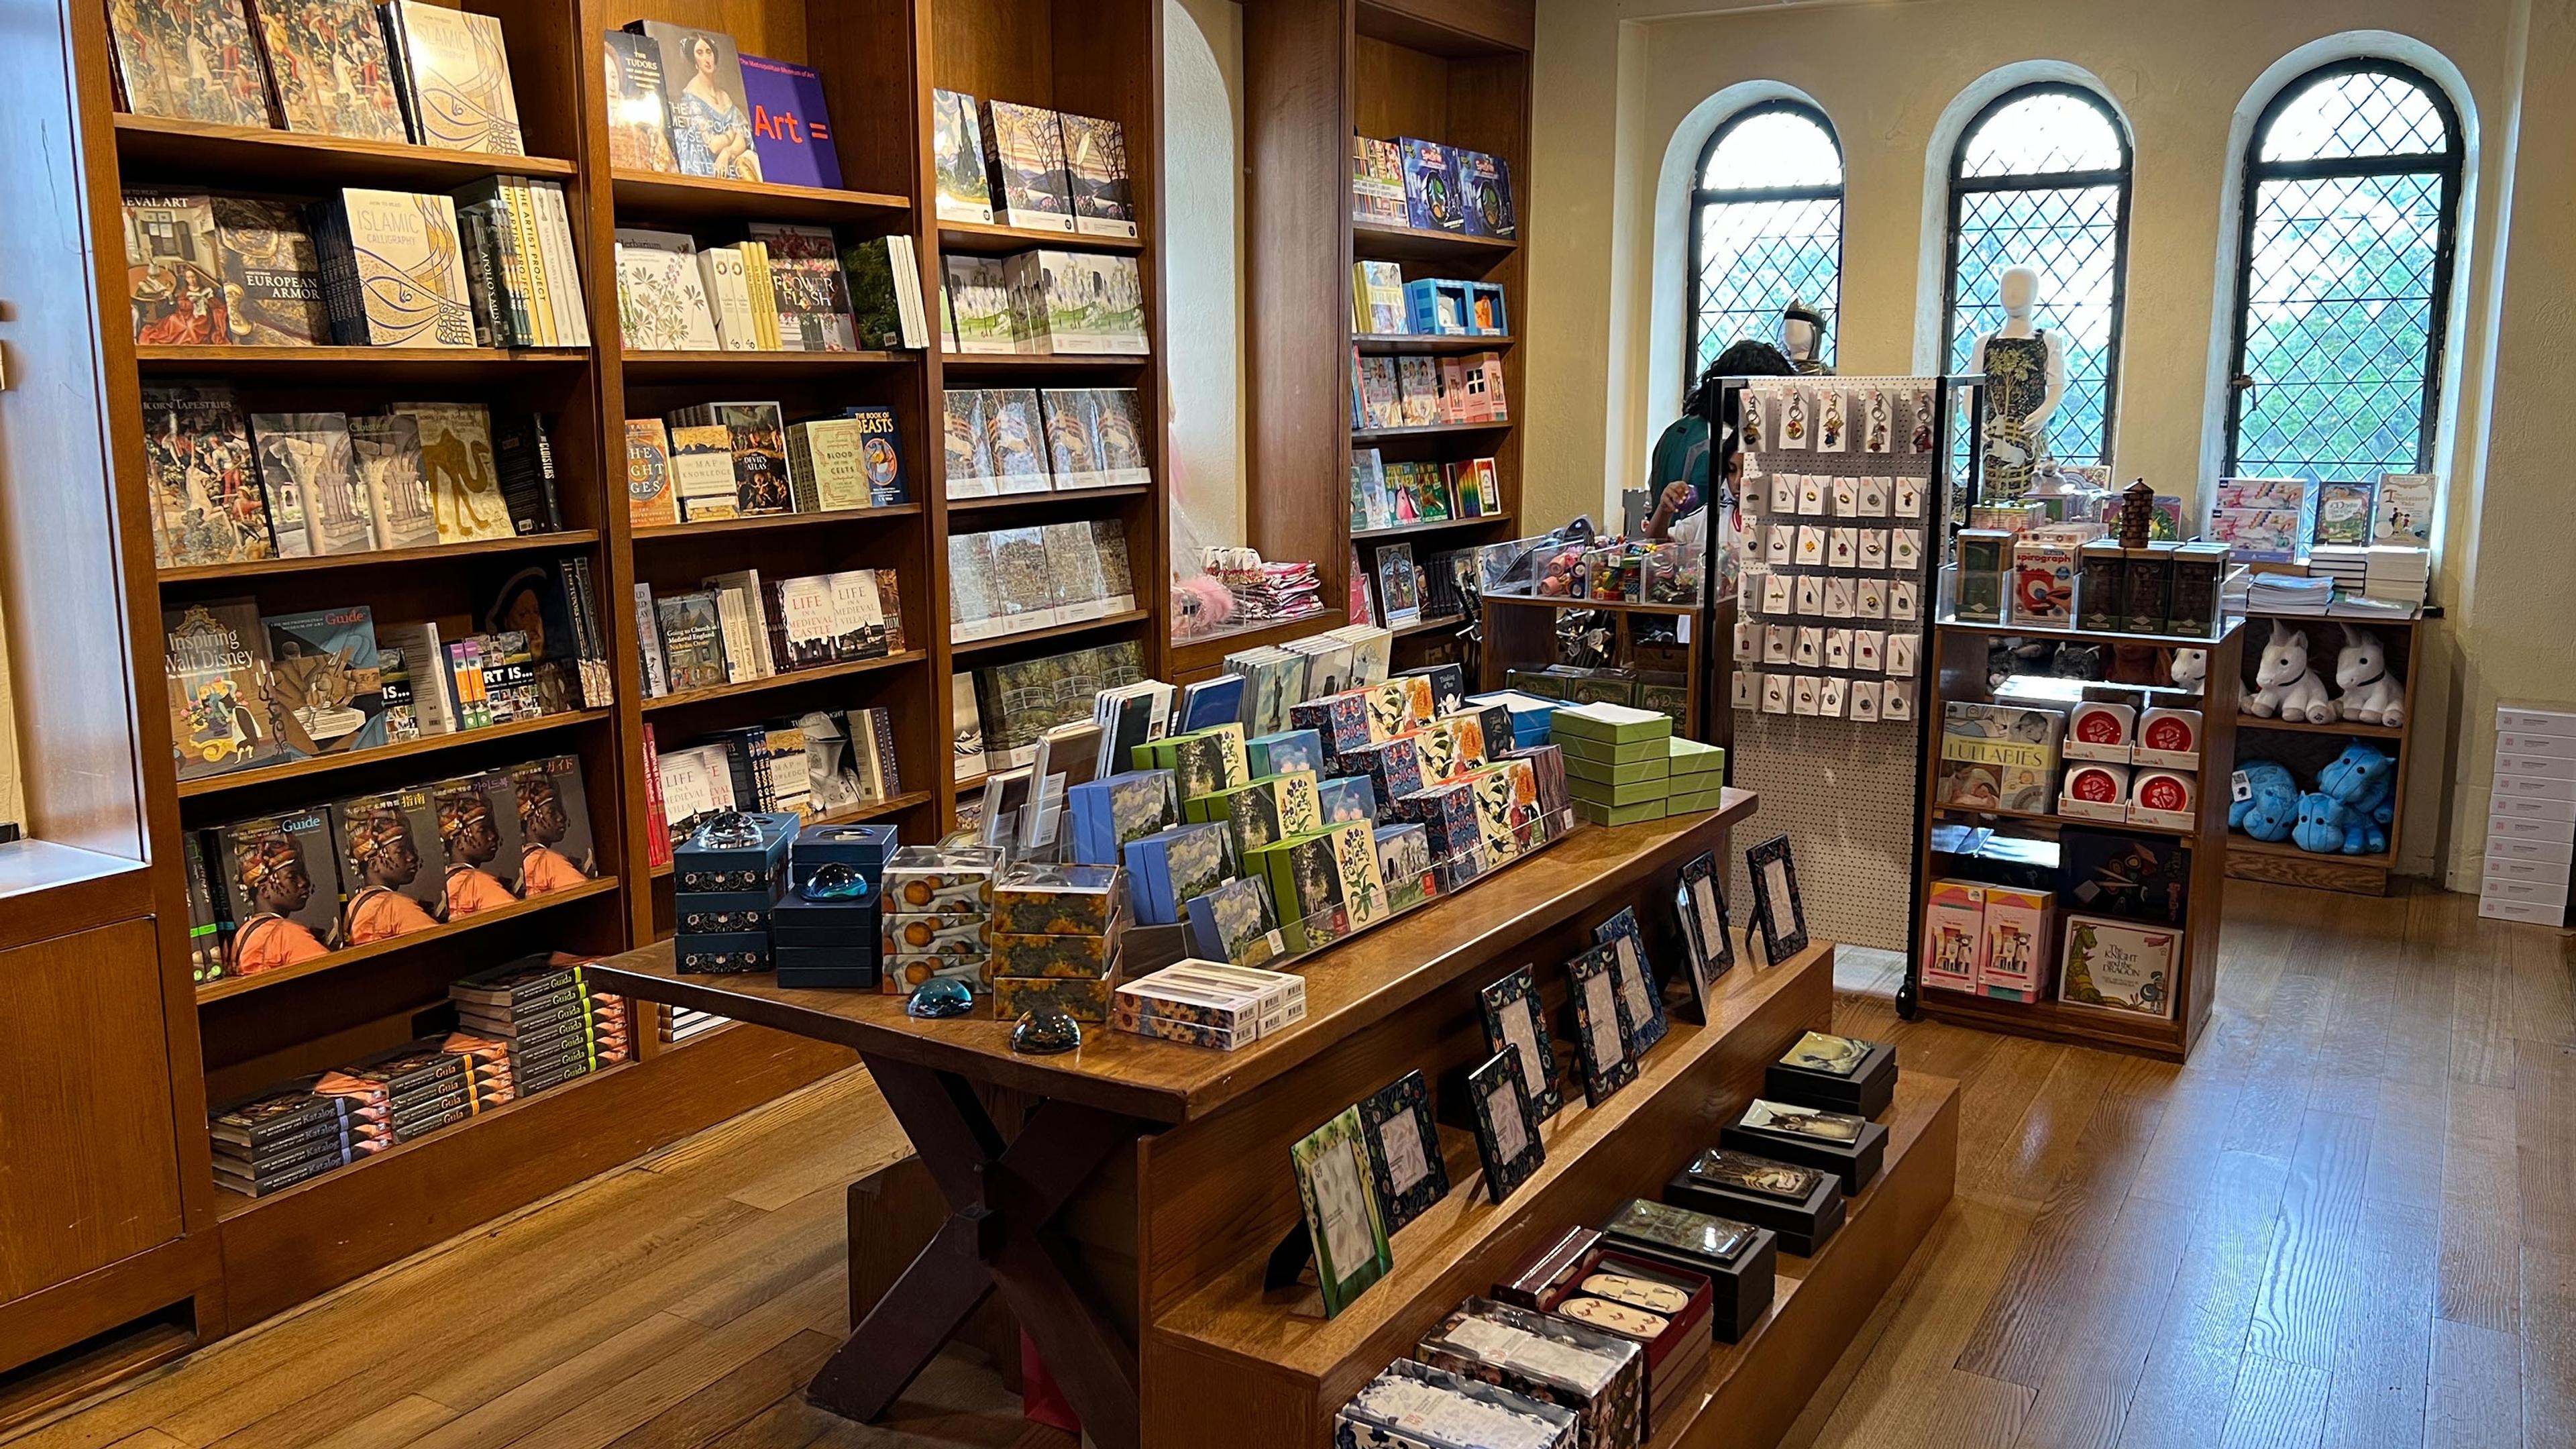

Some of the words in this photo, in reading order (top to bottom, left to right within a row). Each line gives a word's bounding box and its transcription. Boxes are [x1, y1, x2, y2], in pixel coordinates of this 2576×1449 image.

[625, 58, 657, 70] TUDORS
[755, 105, 803, 144] Art
[162, 197, 189, 208] ART
[519, 187, 529, 207] THE
[357, 210, 419, 233] ISLAMIC
[523, 212, 536, 249] ARTIST
[366, 233, 417, 246] CALLIGRAPHY
[508, 211, 521, 249] ARTIST
[517, 253, 532, 302] PROJECT
[247, 276, 317, 288] EUROPEAN
[531, 254, 547, 301] PROJECT
[772, 274, 835, 292] FLOWER
[272, 288, 321, 299] ARMOR
[783, 290, 832, 307] FLASH
[858, 418, 894, 434] BEASTS
[744, 455, 767, 464] DEVIL'S
[827, 451, 853, 460] BLOOD
[630, 464, 664, 477] GHT
[696, 460, 718, 468] MAP
[747, 463, 767, 471] ATLAS
[830, 466, 855, 475] CELTS
[682, 469, 732, 478] KNOWLEDGE
[630, 480, 661, 494] GES
[2017, 554, 2071, 564] spirograph
[839, 586, 867, 600] LIFE
[792, 594, 822, 610] LIFE
[836, 604, 876, 616] MEDIEVAL
[325, 609, 365, 626] Guide
[788, 616, 833, 629] MEDIEVAL
[840, 614, 873, 626] VILLAGE
[667, 629, 684, 637] Going
[691, 625, 711, 633] Church
[668, 635, 692, 643] Medieval
[693, 631, 715, 641] England
[792, 625, 831, 638] CASTLE
[168, 630, 239, 653] Inspiring
[165, 654, 198, 674] Walt
[202, 650, 254, 669] Disney
[508, 667, 534, 680] IS...
[1949, 743, 2043, 767] LULLABIES
[547, 758, 573, 772] ガイド
[775, 762, 794, 771] MAP
[473, 777, 509, 791] 가이드북
[666, 771, 695, 788] LIFE
[402, 793, 426, 808] 指南
[667, 800, 702, 814] VILLAGE
[282, 816, 321, 833] Guide
[2109, 944, 2123, 953] The
[2105, 951, 2139, 963] KNIGHT
[2103, 965, 2141, 977] DRAGON
[551, 975, 572, 988] Guida
[553, 991, 576, 1005] Guida
[557, 1006, 580, 1020] Guida
[559, 1020, 582, 1035] Guida
[561, 1035, 584, 1049] Guida
[562, 1050, 585, 1064] Guida
[564, 1065, 586, 1079] Guida
[303, 1107, 335, 1124] Katalog
[305, 1123, 339, 1139] Katalog
[306, 1140, 340, 1157] Katalog
[308, 1157, 342, 1175] Katalog
